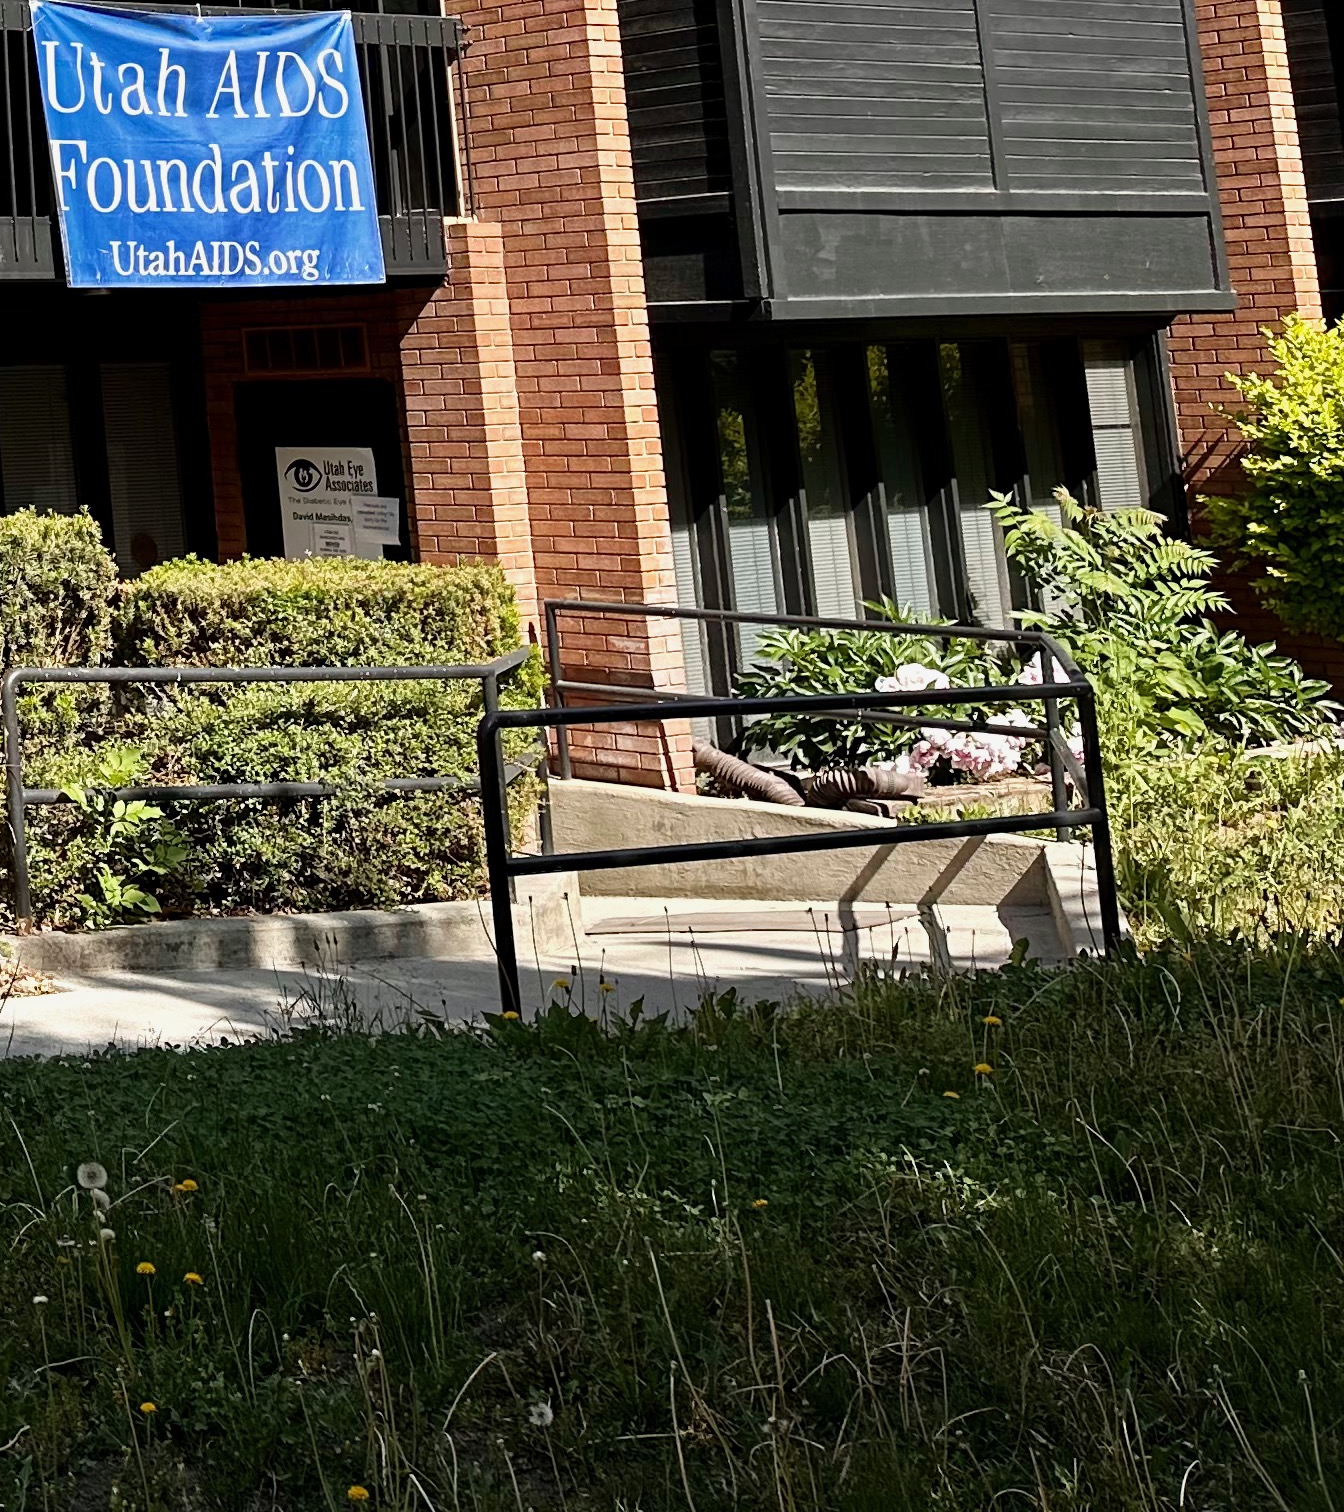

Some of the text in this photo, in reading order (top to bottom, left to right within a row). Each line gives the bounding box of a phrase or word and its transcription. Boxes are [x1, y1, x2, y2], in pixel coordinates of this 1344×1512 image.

[42, 40, 350, 120] Utah AIDS
[50, 138, 365, 214] Foundation
[109, 238, 320, 280] UtahAIDS.org
[323, 459, 364, 479] Utah Eye
[325, 476, 374, 492] Associates
[292, 511, 314, 520] David
